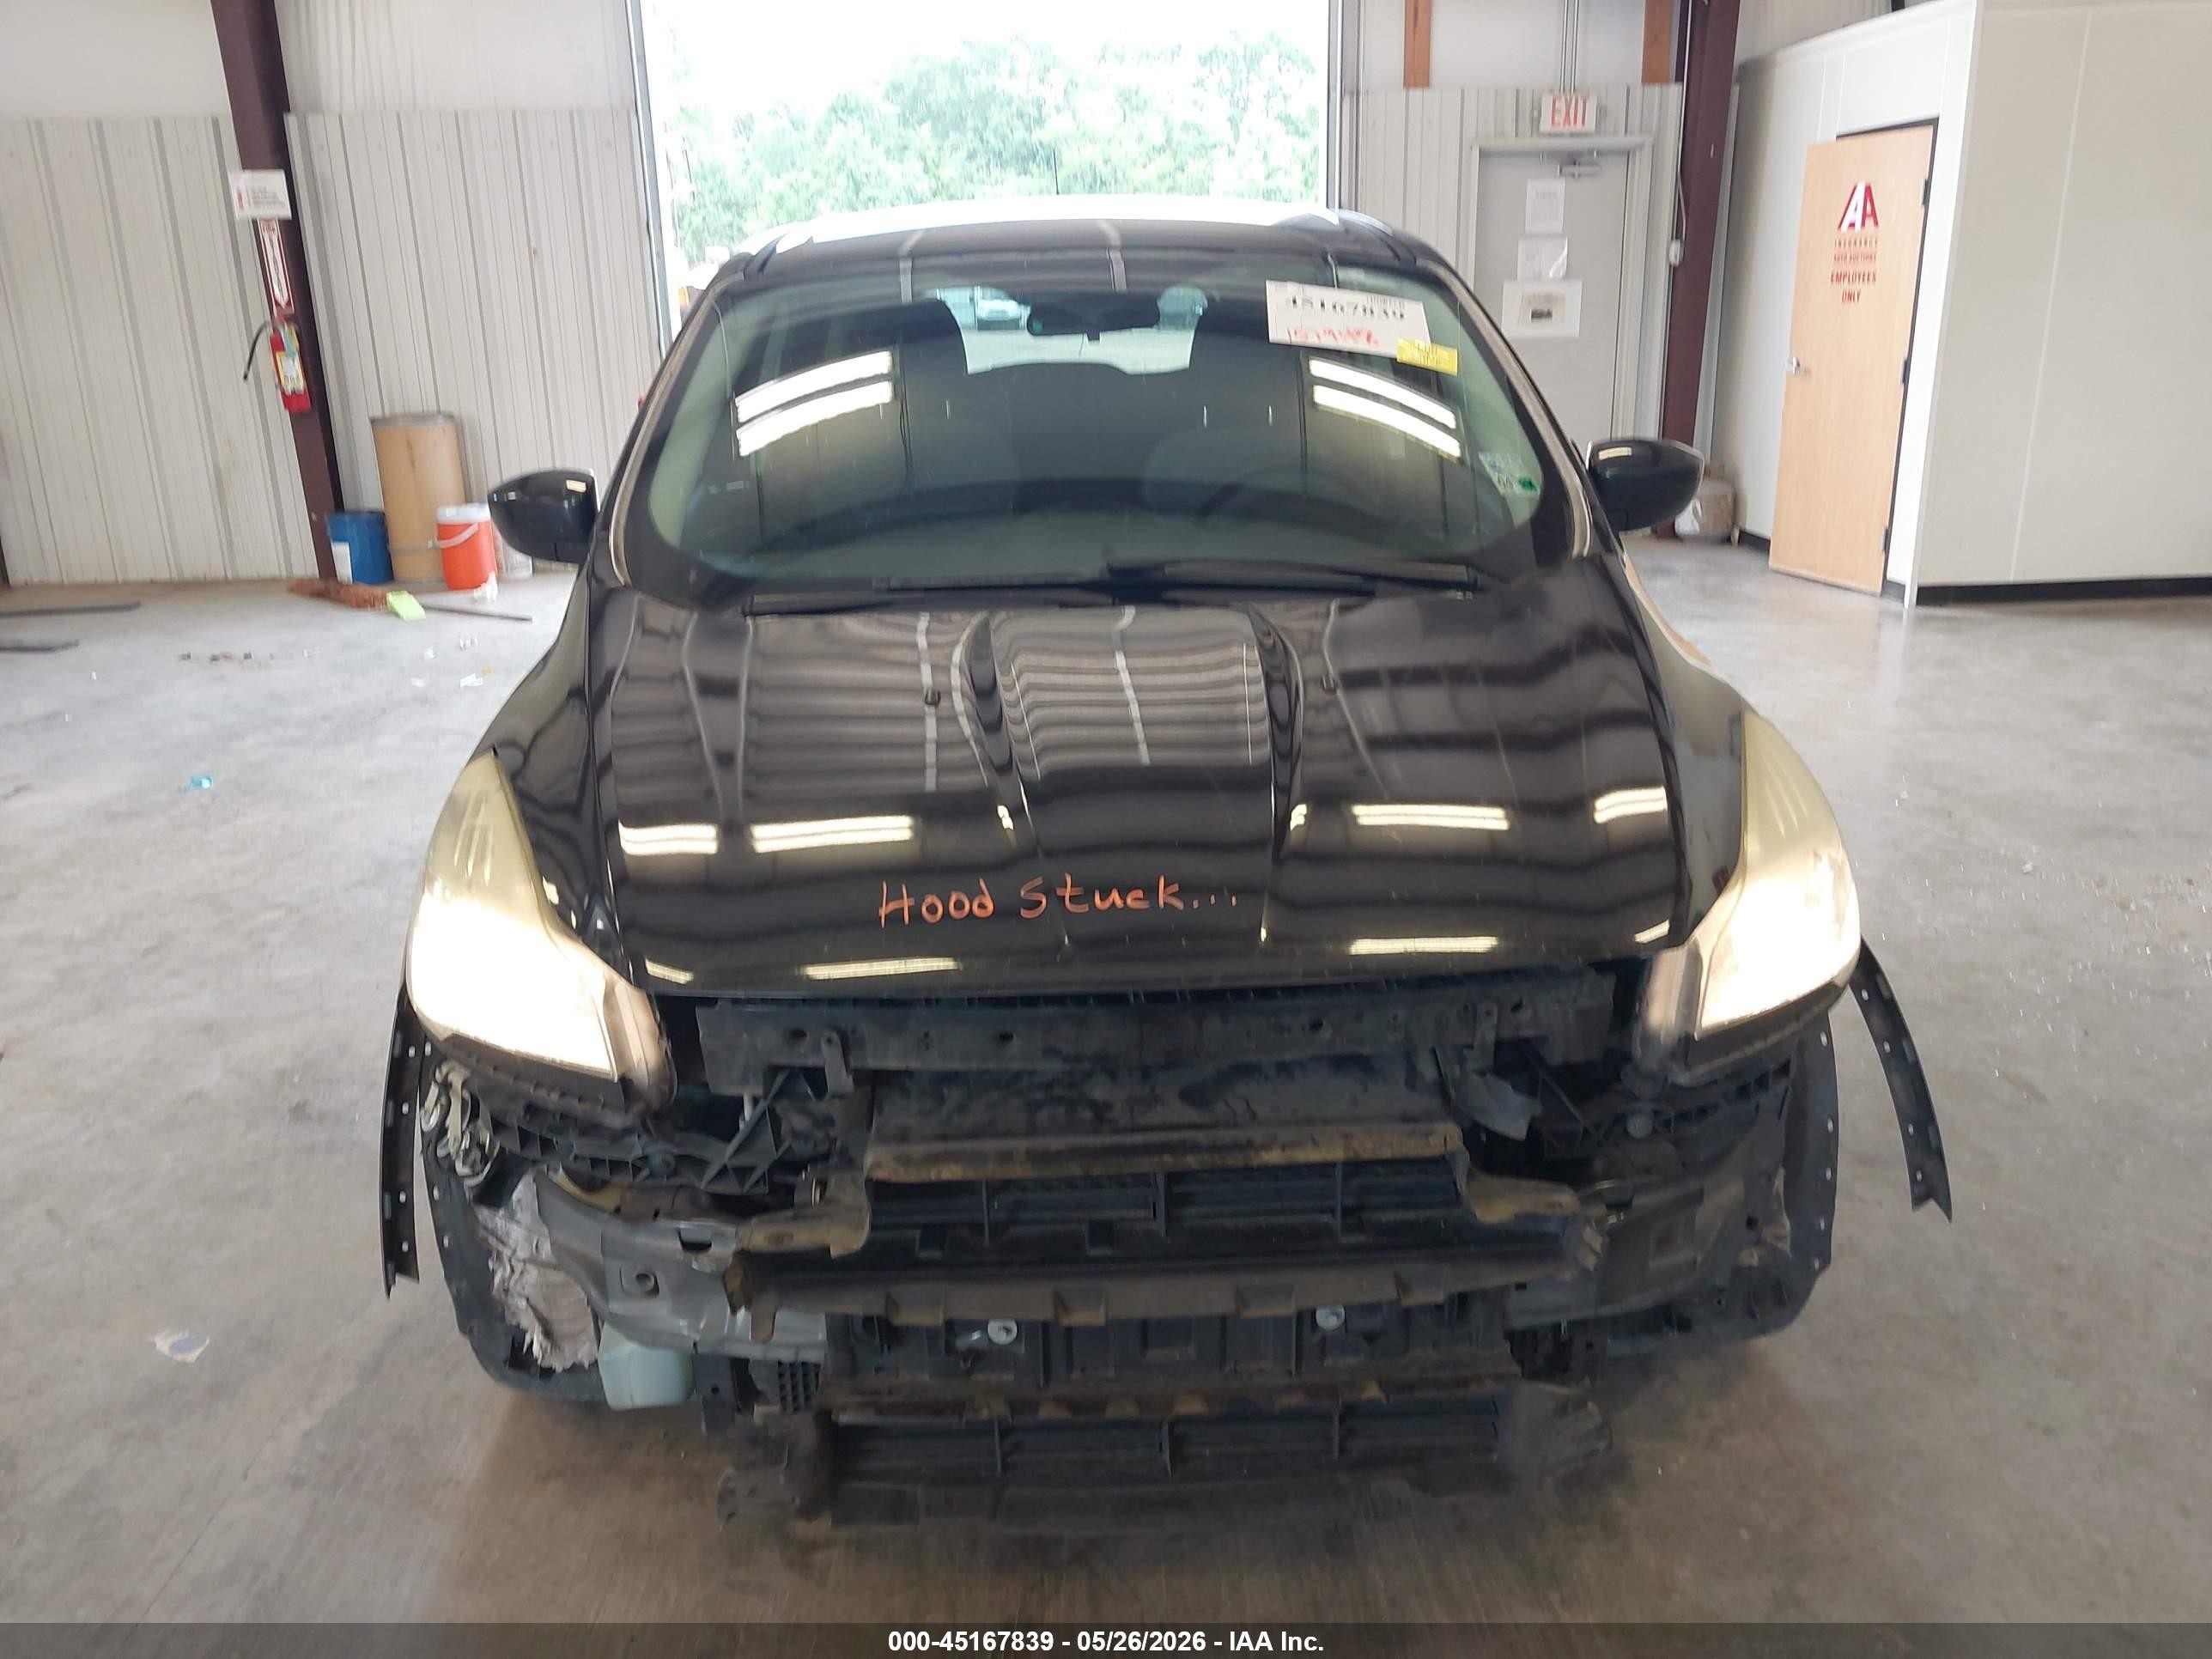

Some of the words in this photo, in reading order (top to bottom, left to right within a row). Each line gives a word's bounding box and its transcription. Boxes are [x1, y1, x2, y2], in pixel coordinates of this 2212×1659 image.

[1551, 94, 1588, 128] EXIT
[1830, 270, 1876, 286] EMPLOYEES
[1841, 288, 1862, 304] ONLY
[878, 877, 995, 928] Hood
